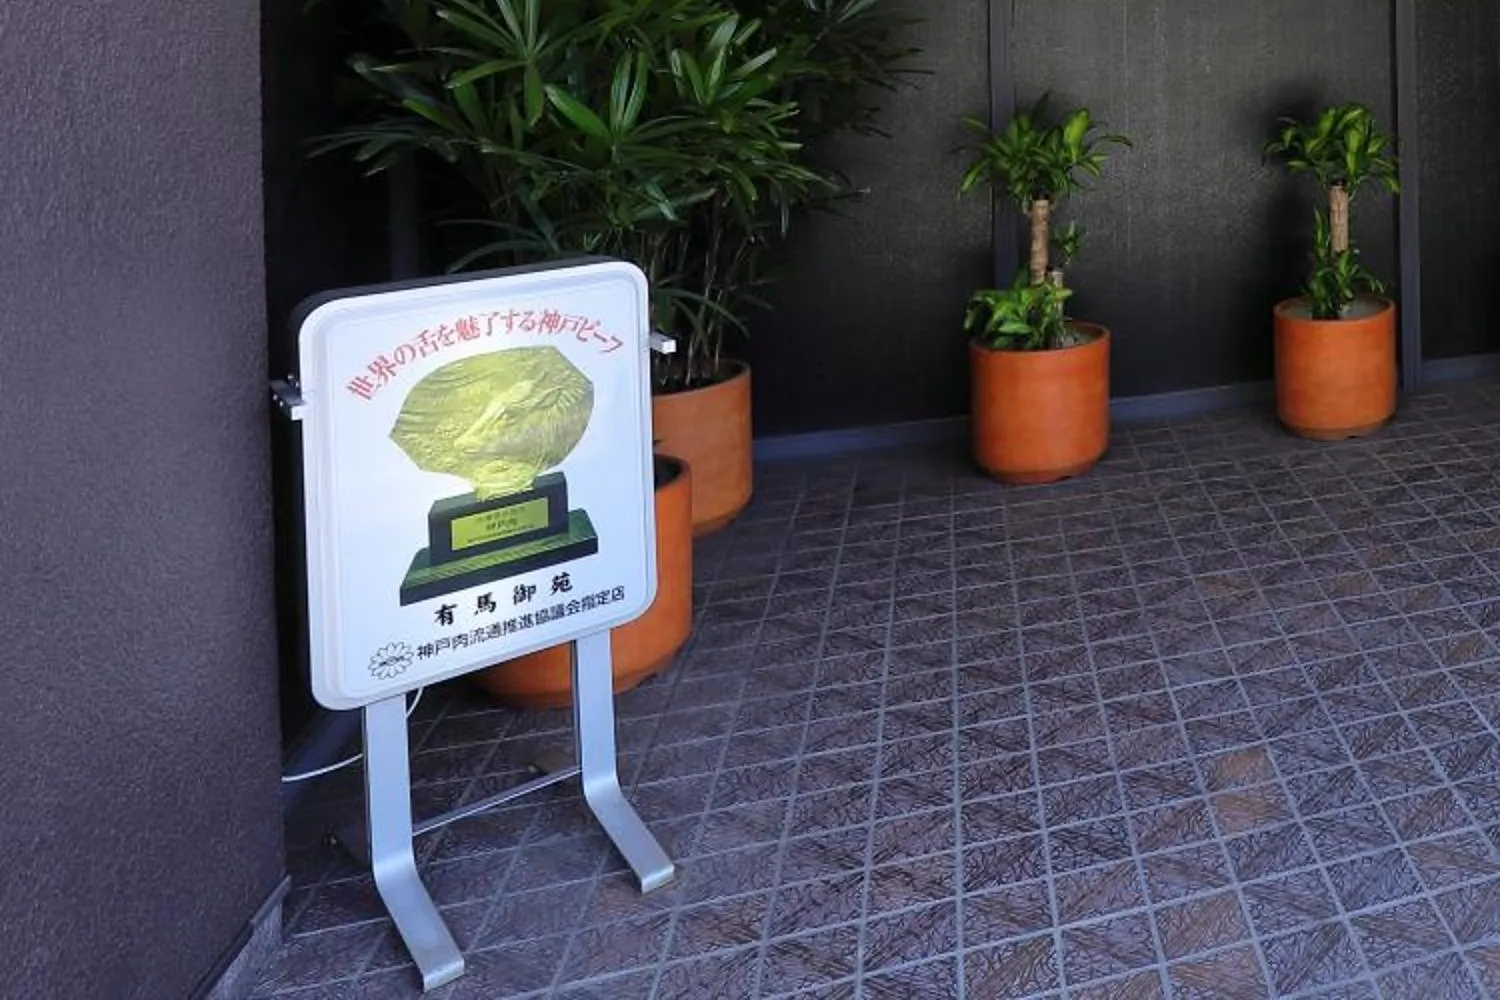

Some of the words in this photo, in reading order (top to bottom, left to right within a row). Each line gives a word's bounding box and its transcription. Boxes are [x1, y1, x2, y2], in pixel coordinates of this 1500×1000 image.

[416, 586, 625, 660] 神戸肉流通推進協議会指定店
[434, 572, 573, 626] 有馬御苑
